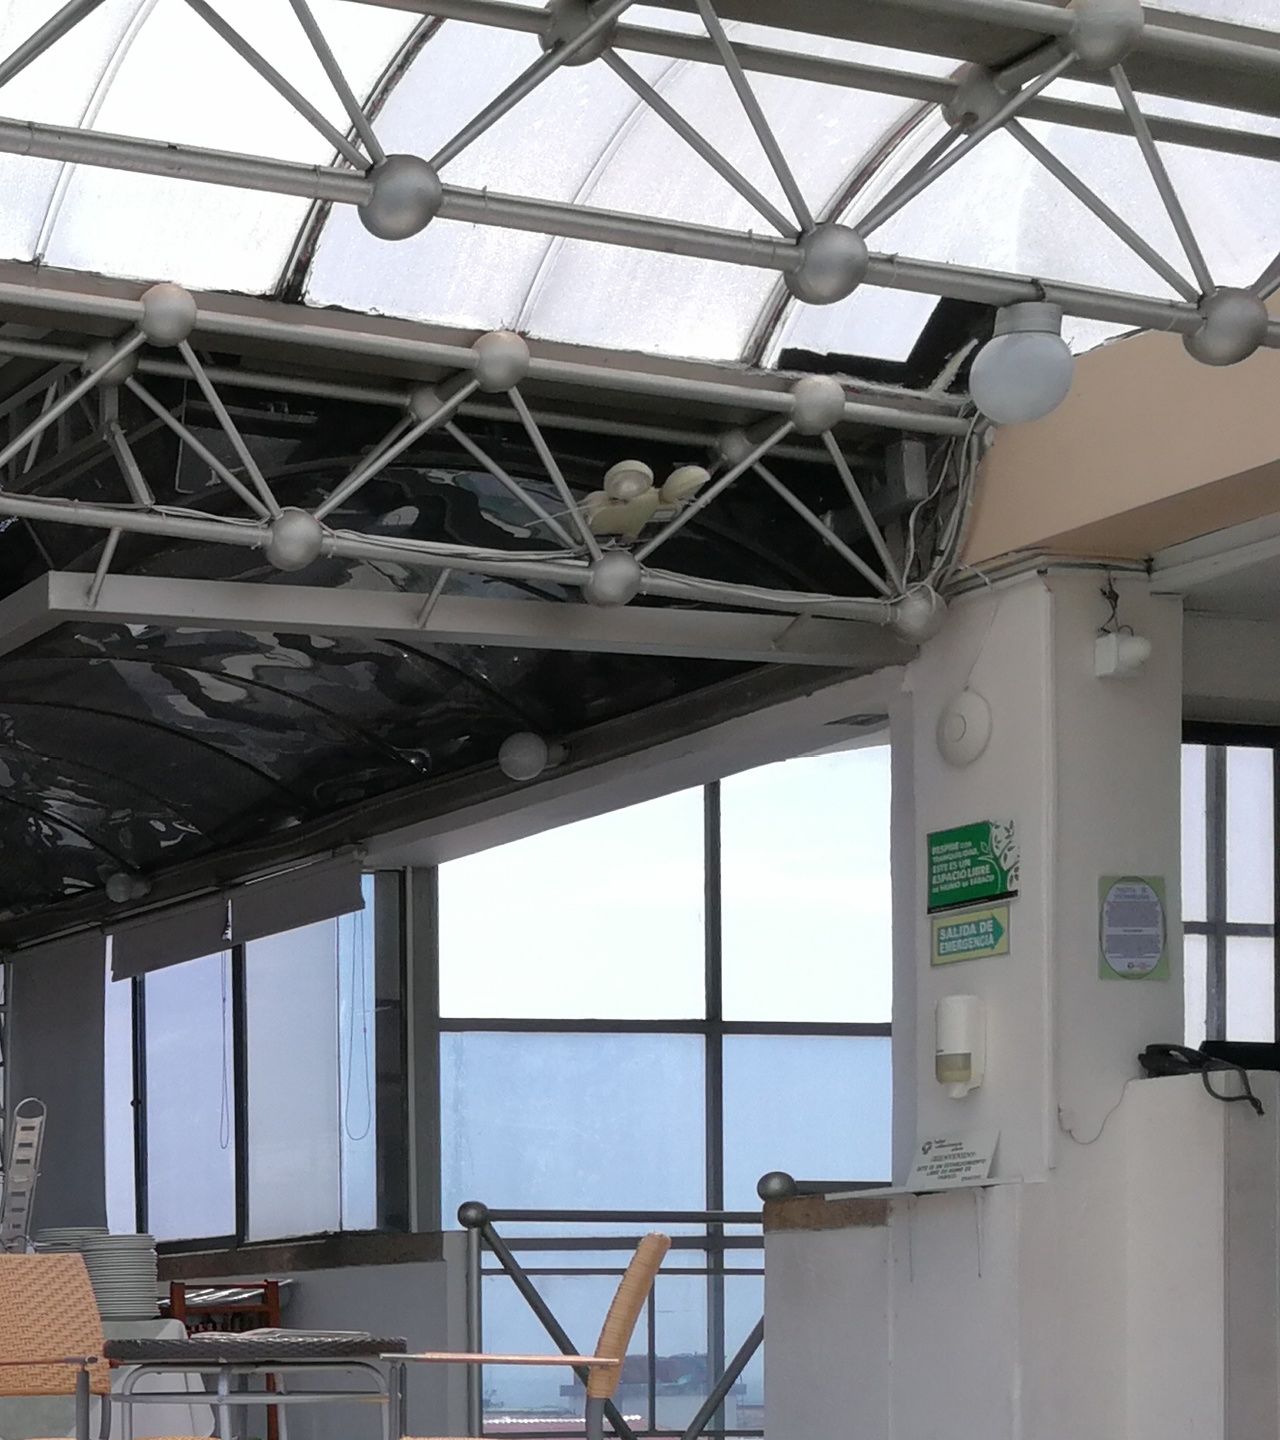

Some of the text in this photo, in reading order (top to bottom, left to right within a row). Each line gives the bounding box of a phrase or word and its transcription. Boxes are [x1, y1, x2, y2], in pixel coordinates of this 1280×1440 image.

[932, 863, 991, 885] ESPACIO LIBRE
[949, 861, 958, 871] ES
[958, 858, 971, 869] UN
[939, 919, 994, 940] SALIDA DE
[939, 933, 994, 954] EMERGENCIA
